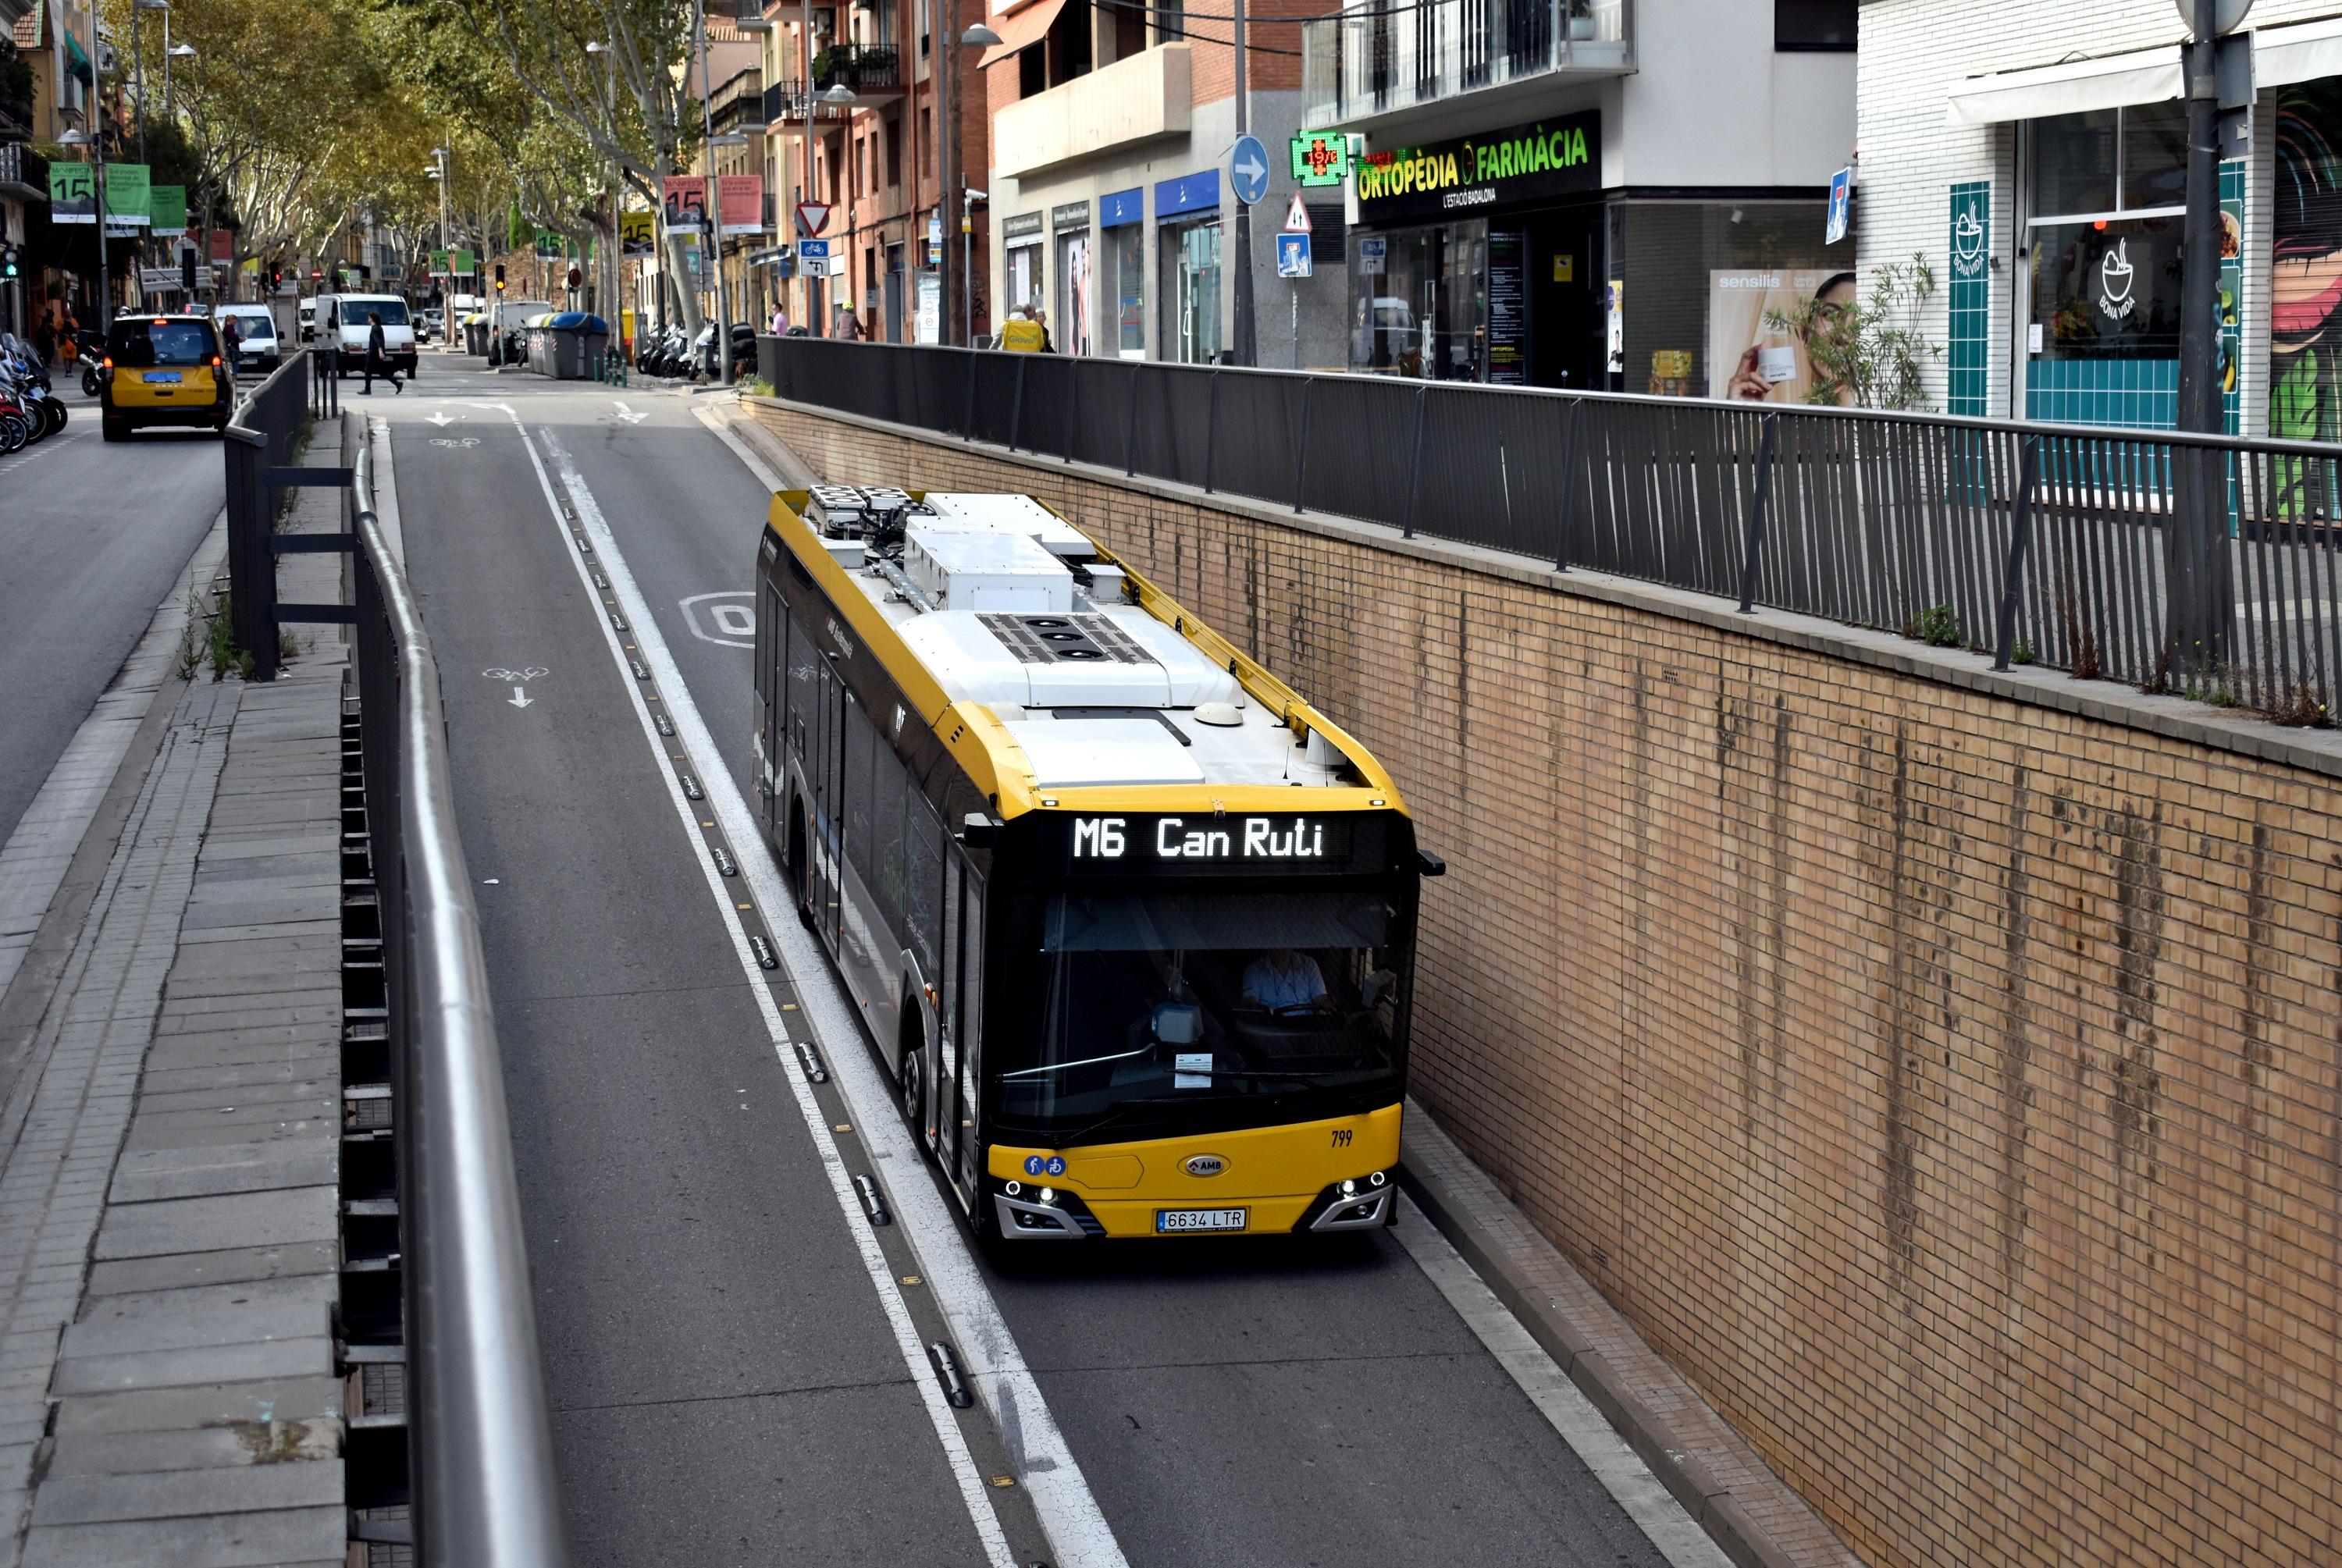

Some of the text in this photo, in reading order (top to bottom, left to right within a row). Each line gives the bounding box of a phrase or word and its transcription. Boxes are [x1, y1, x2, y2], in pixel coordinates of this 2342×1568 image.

[1358, 125, 1587, 201] ORTOPÈDIA FARMÀCIA
[54, 178, 93, 200] 15
[1443, 188, 1496, 208] L'ESTACIÓ BADALONA
[667, 190, 706, 215] 15
[624, 223, 652, 241] 15
[1953, 254, 1984, 277] BONA VIDA
[1719, 275, 1780, 288] sensilis
[2099, 294, 2135, 320] BONA VIDA
[1073, 817, 1322, 857] M6 Can Ruti
[1332, 1129, 1353, 1148] 799
[1200, 1161, 1222, 1171] AMB
[1168, 1212, 1207, 1227] 6634
[1212, 1211, 1242, 1226] LTR
